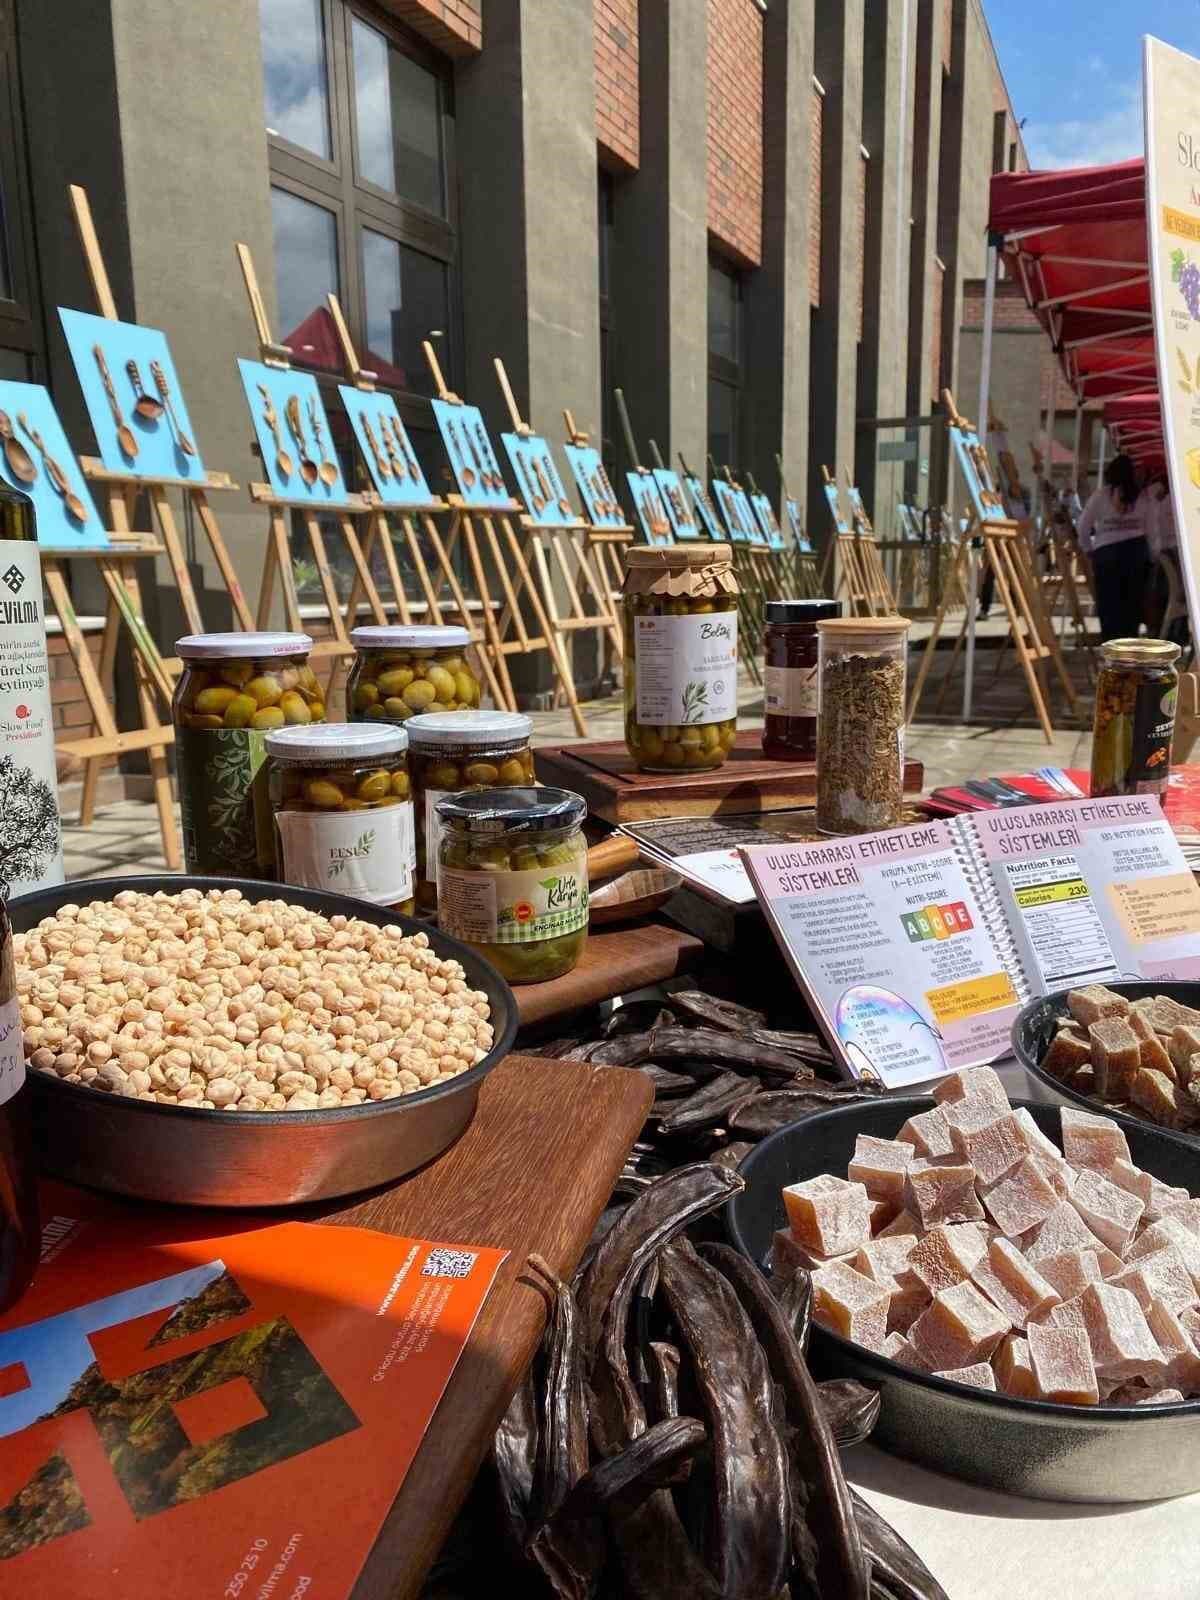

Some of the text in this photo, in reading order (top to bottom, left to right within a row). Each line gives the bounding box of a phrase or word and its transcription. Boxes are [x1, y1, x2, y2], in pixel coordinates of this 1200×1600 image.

[0, 720, 23, 732] Slow
[988, 801, 1152, 833] ULUSLARARASI ETİKETLEME
[766, 844, 857, 871] ULUSLARARASI
[858, 828, 940, 858] ETİKETLEME
[999, 825, 1081, 854] SİSTEMLERİ
[778, 863, 860, 893] SİSTEMLERİ
[1006, 856, 1077, 874] Nutrition Facts
[1018, 894, 1052, 905] Calories
[1068, 885, 1088, 897] 230
[224, 1538, 269, 1598] 250 25 10
